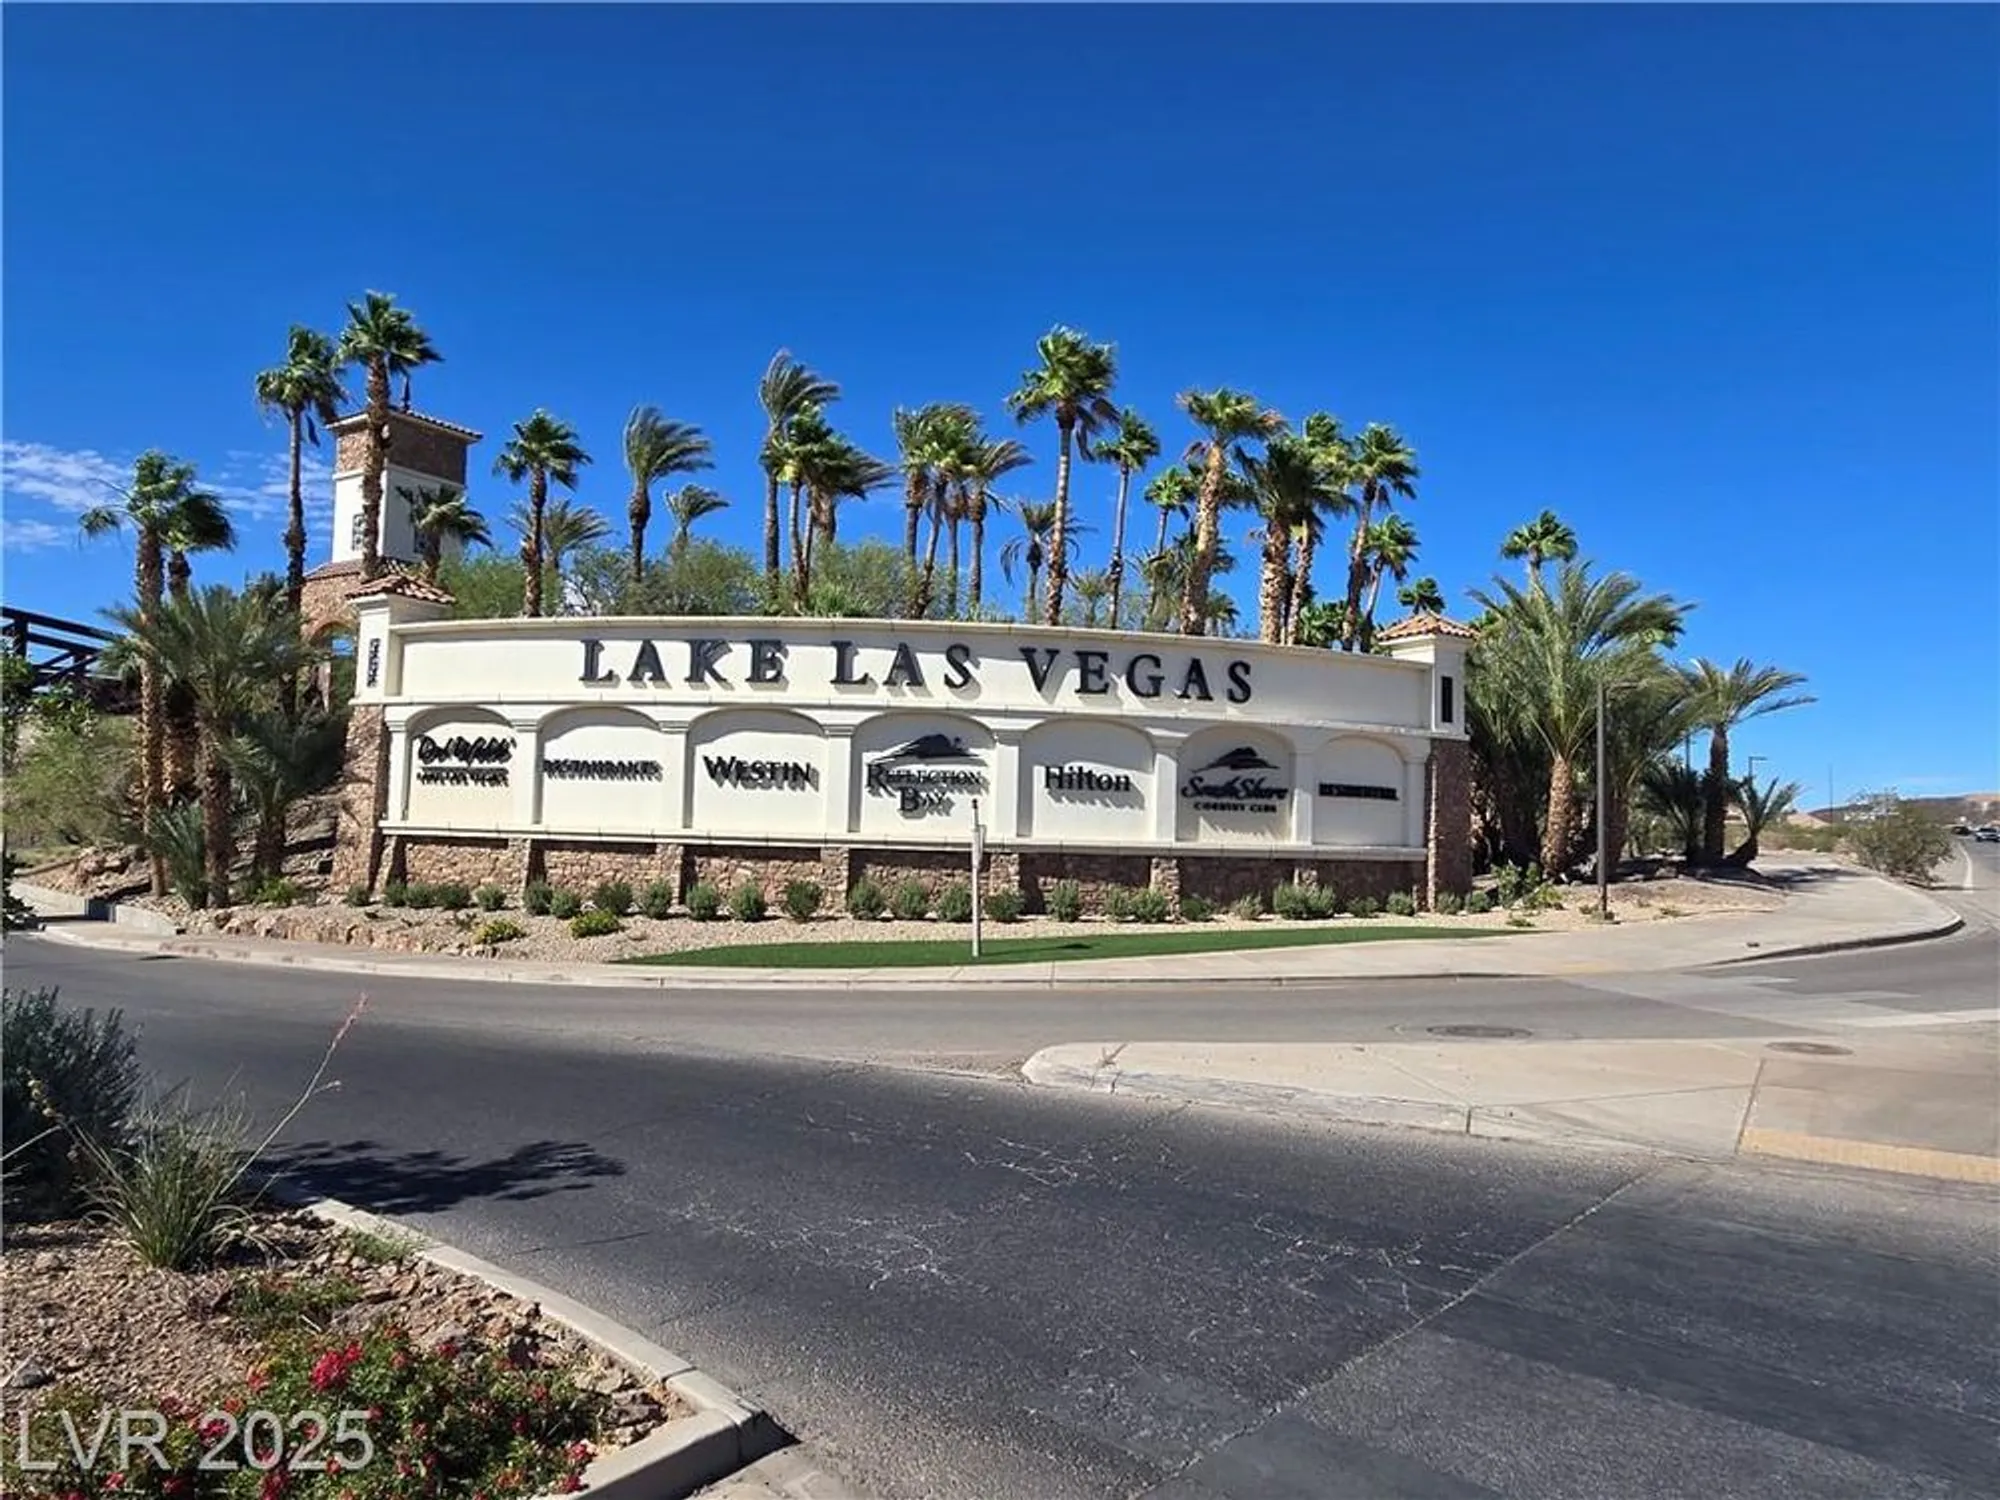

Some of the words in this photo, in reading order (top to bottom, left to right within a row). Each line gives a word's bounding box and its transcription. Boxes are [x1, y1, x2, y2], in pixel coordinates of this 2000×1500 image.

[579, 639, 785, 684] LAKE
[830, 640, 972, 690] LAS
[1019, 647, 1253, 704] VEGAS
[702, 755, 812, 783] WESTIN
[1044, 765, 1131, 792] Hilton
